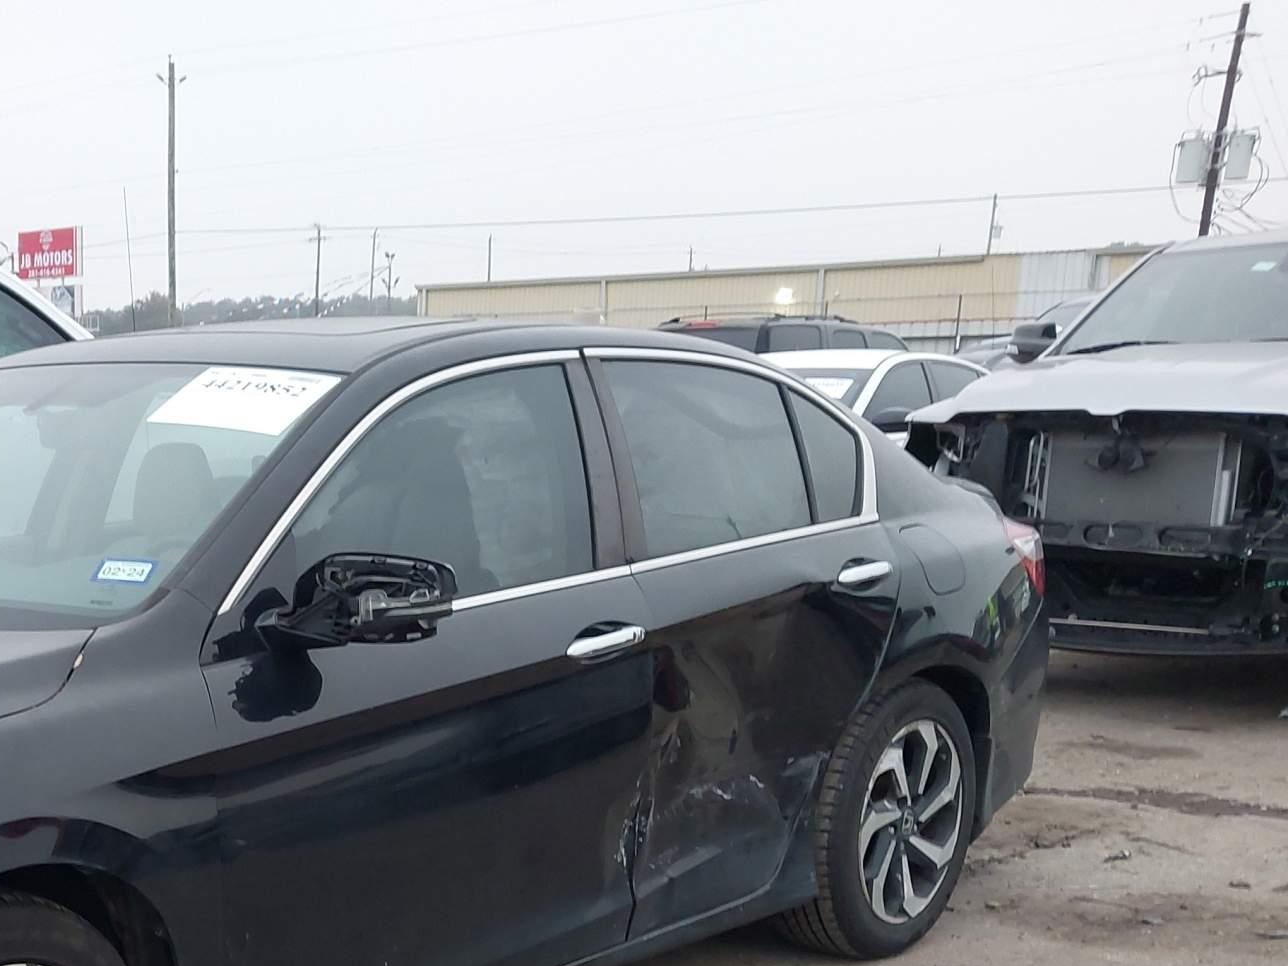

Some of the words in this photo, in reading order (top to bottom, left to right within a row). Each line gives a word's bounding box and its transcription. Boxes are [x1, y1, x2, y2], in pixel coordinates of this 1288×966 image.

[20, 252, 32, 270] JB
[34, 248, 73, 269] MOTORS
[202, 379, 308, 398] 44219852
